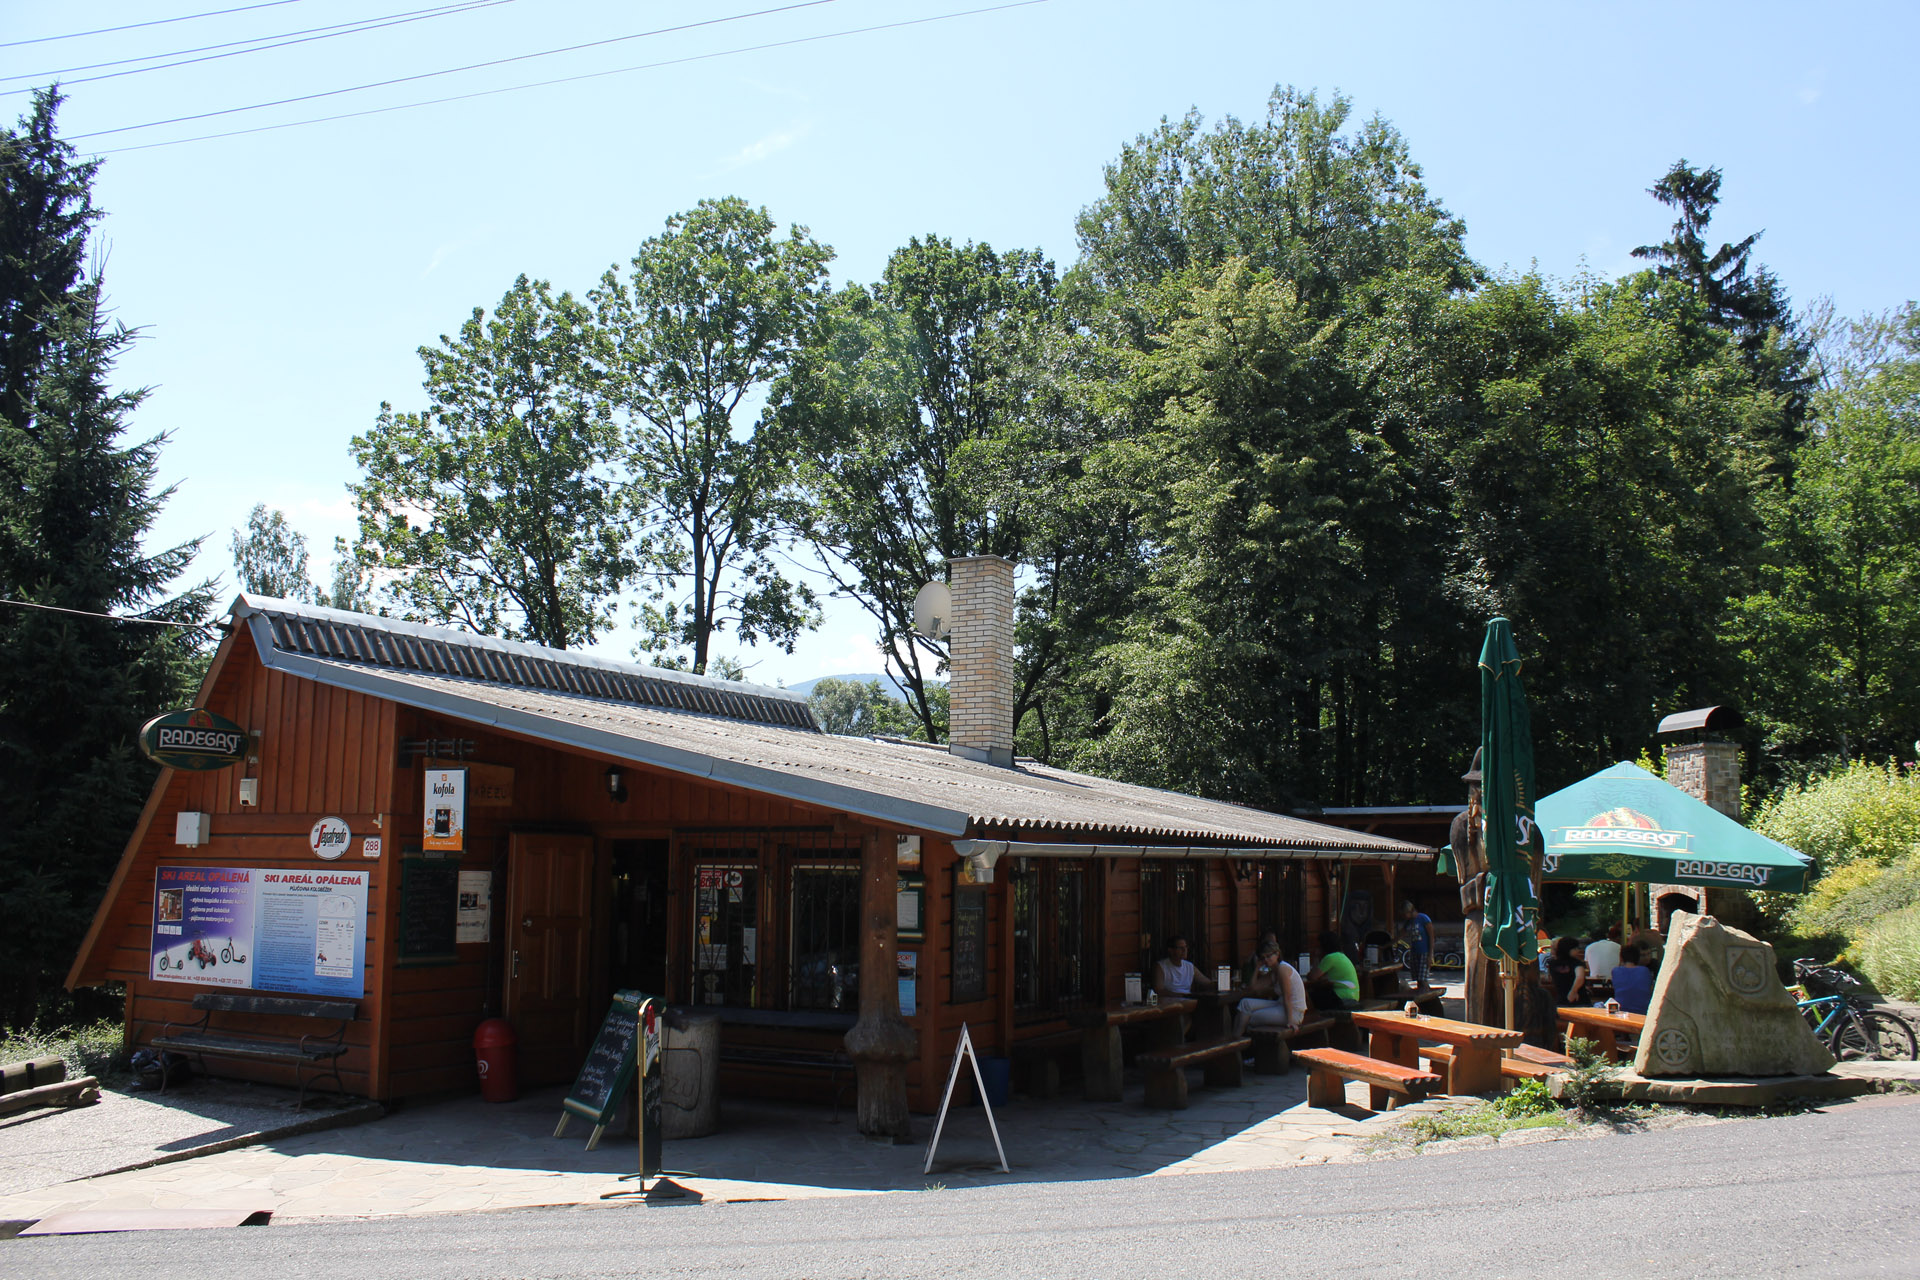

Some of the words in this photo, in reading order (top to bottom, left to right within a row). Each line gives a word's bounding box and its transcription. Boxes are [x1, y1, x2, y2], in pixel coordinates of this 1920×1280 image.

[159, 729, 241, 754] RADEGAST
[433, 782, 455, 798] kofola
[365, 840, 379, 851] 288
[1565, 829, 1677, 846] RADEGAST
[161, 871, 177, 881] SKI
[207, 870, 250, 883] OPÁLENÁ
[263, 874, 280, 883] SKI
[281, 873, 313, 884] AREÁL
[315, 874, 361, 885] OPÁLENÁ
[1675, 859, 1773, 886] RADEGAST
